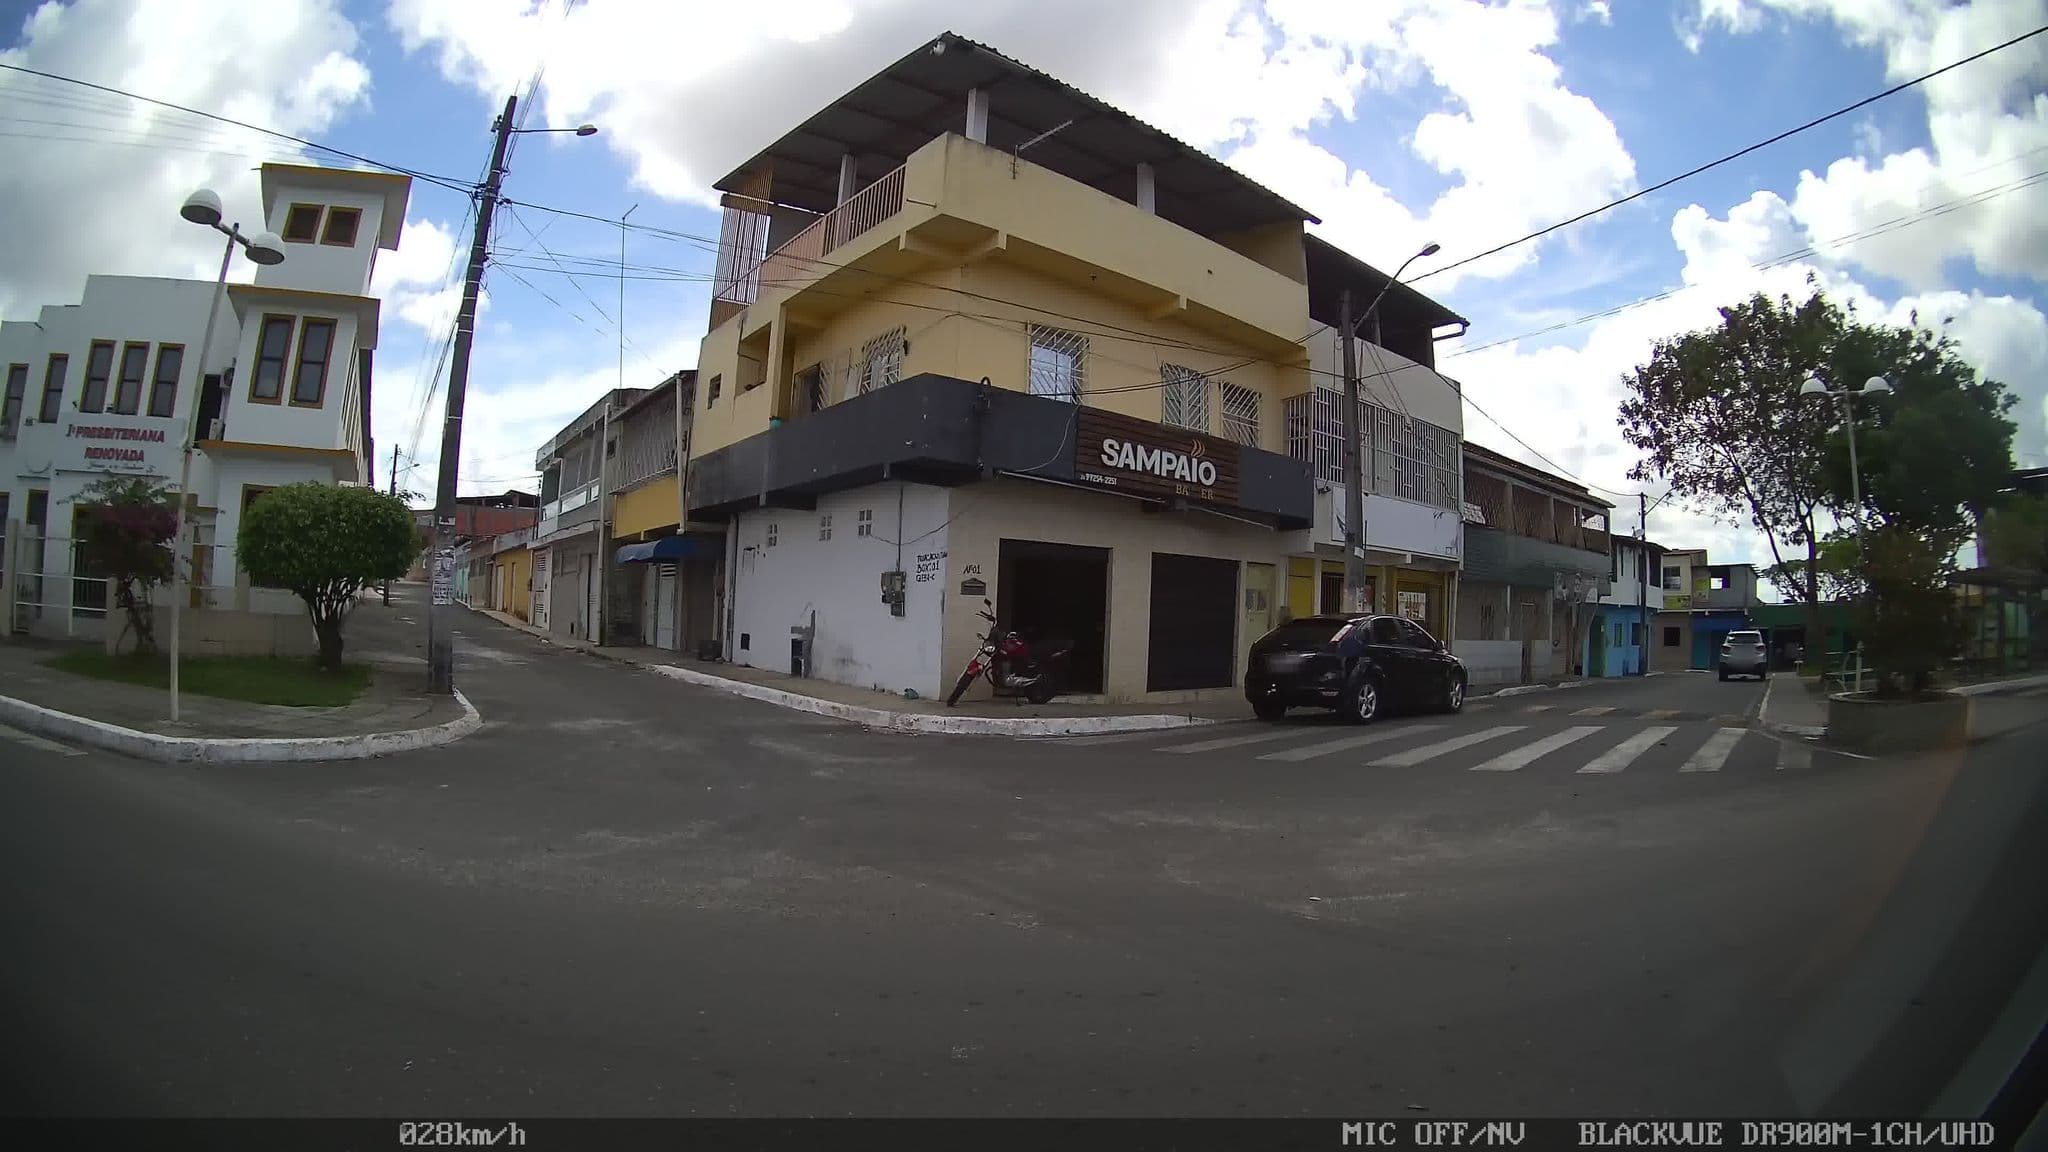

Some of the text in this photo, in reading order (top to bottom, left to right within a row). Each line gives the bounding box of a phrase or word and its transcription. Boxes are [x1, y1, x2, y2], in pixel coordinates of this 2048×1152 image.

[75, 426, 165, 443] PRESBITERIANA
[84, 446, 145, 462] RENOVADA
[1101, 438, 1217, 486] SAMPAIO
